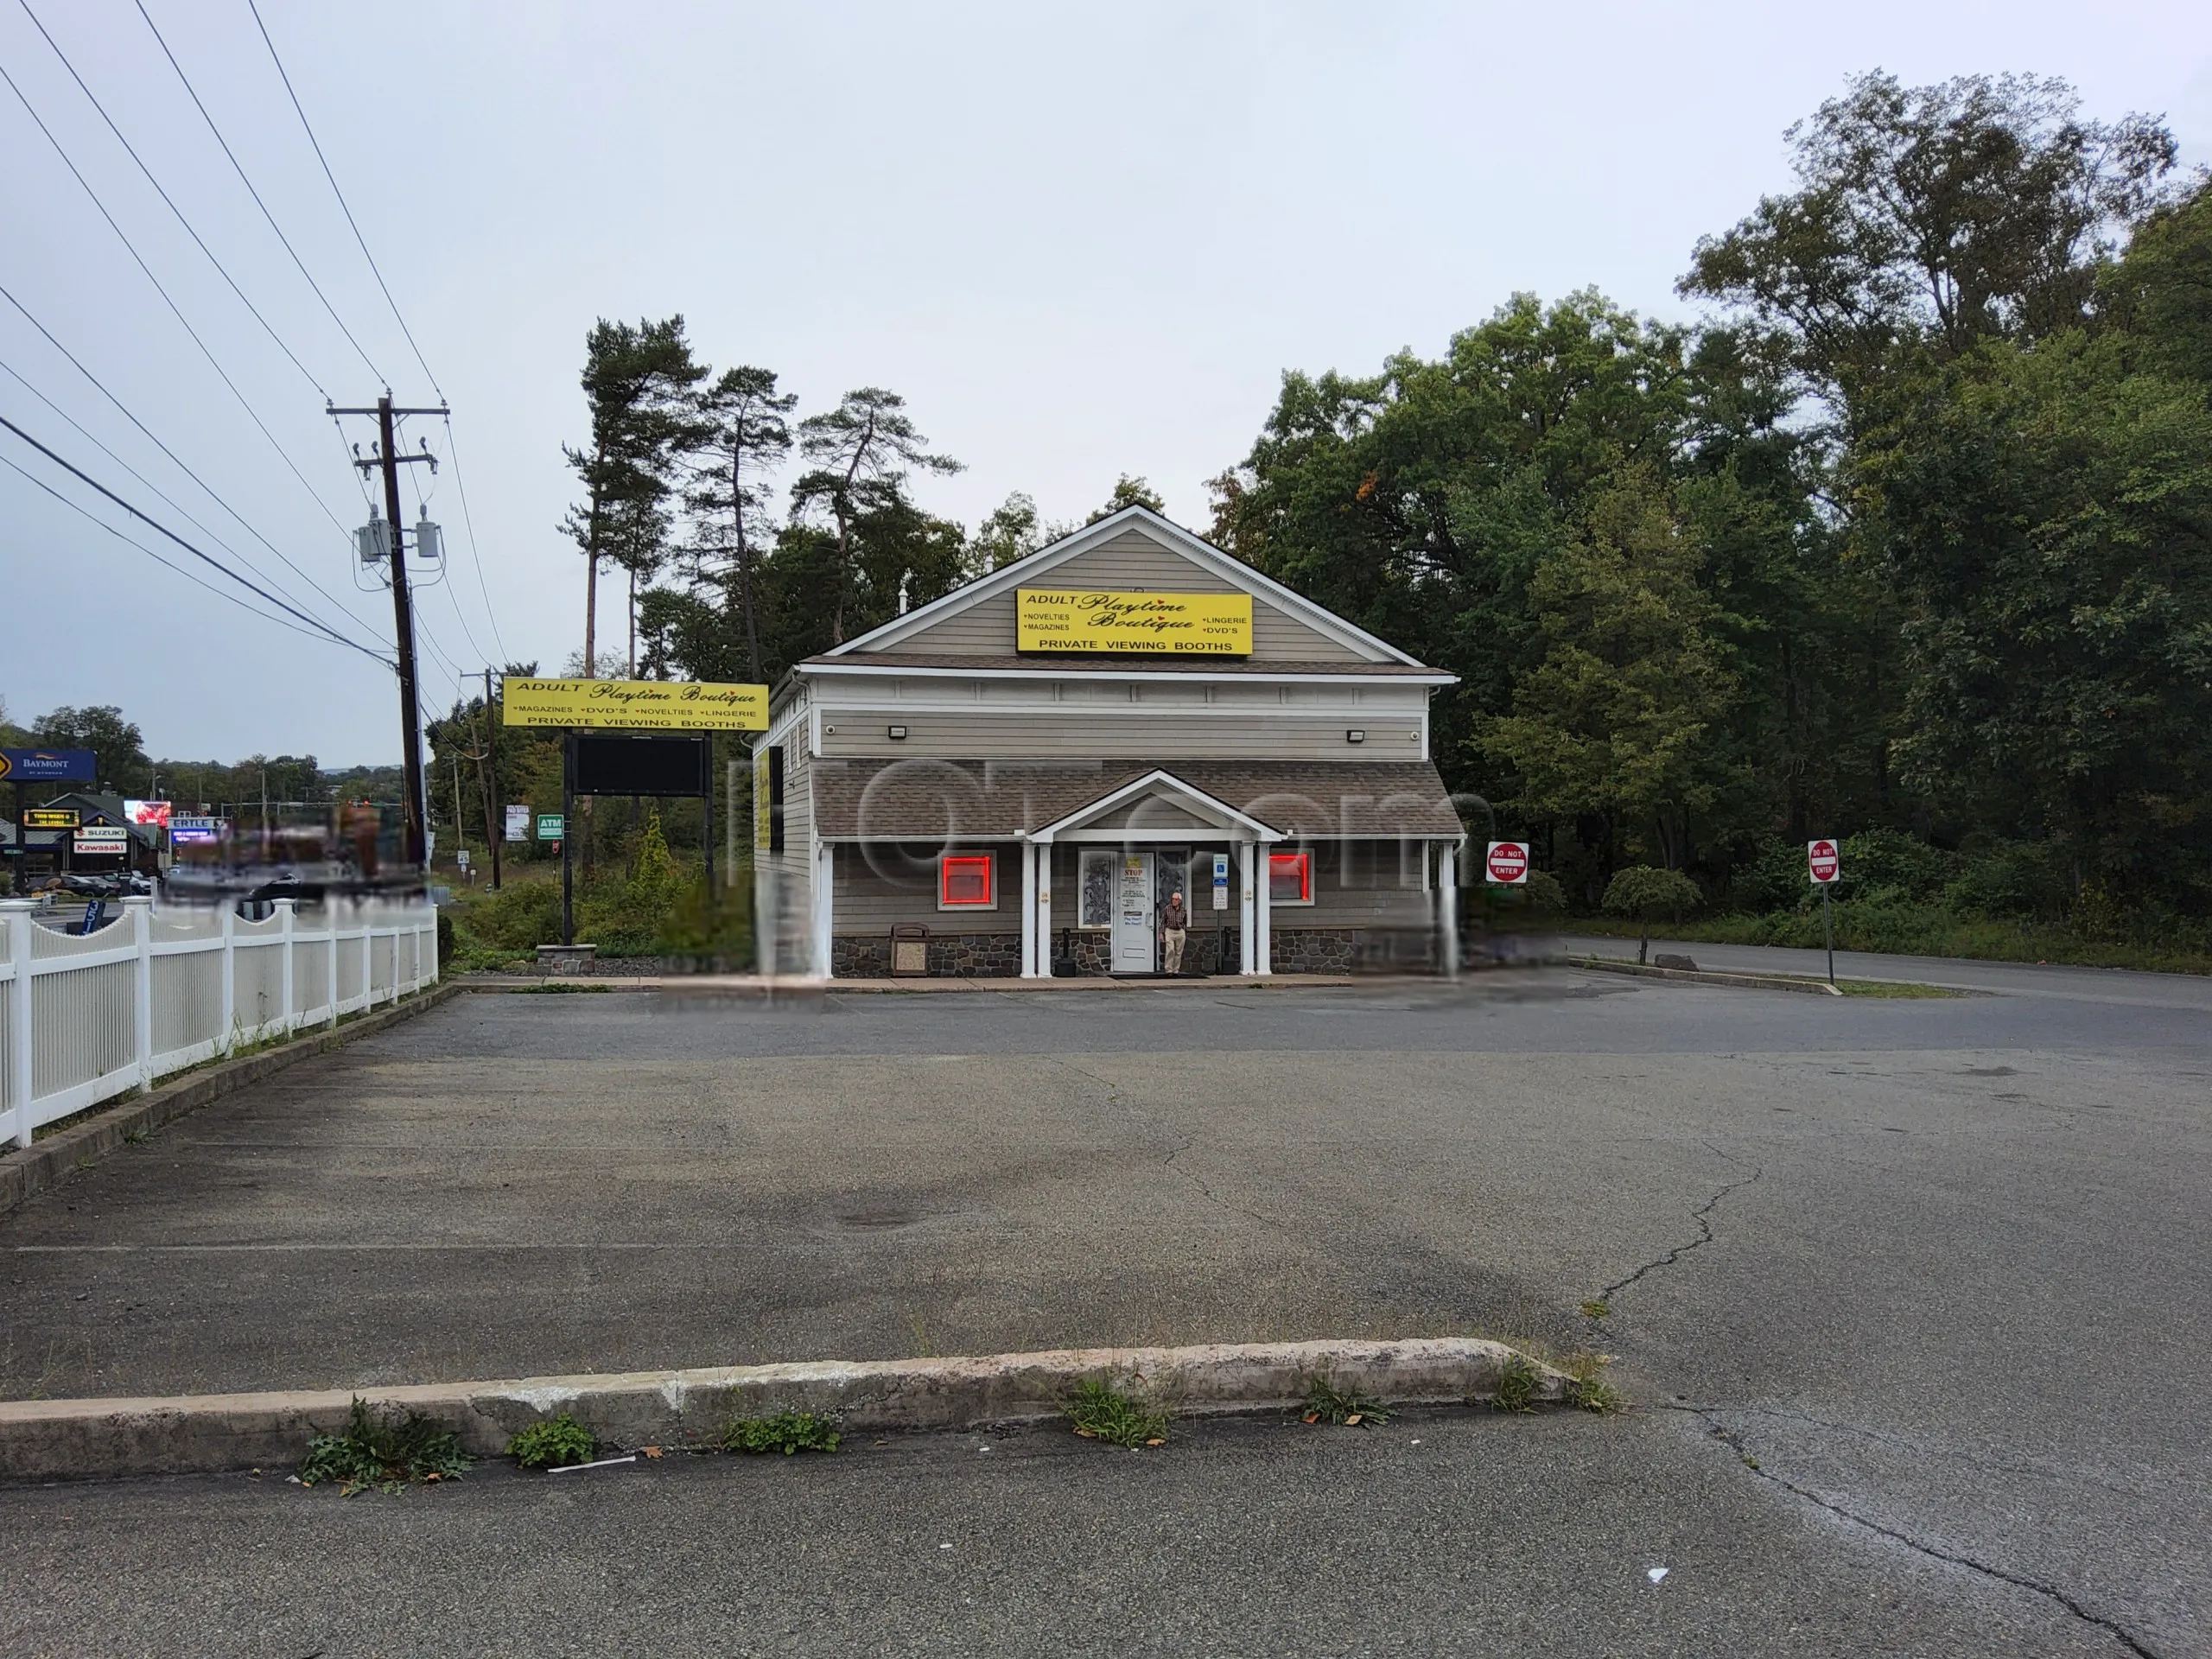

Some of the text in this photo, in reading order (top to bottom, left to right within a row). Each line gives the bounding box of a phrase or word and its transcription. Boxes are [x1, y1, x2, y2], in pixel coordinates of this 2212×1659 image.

[1026, 594, 1187, 616] ADULT Playtime
[1027, 613, 1071, 621] NOVELTIES
[1087, 611, 1195, 633] Boutique
[1027, 623, 1070, 632] MAGAZINES
[1039, 639, 1233, 651] PRIVATE VIEWING BOOTHS
[516, 683, 757, 707] ADULT Playtime Boutique
[518, 705, 573, 714] MAGAZINES
[705, 709, 757, 718] LINGERIE
[527, 716, 747, 728] PRIVATE VIEWING BOOTHS
[22, 759, 69, 768] BAYMONT
[173, 819, 208, 828] ERTLE
[540, 818, 562, 828] ATM
[1822, 848, 1833, 856] NOT
[1815, 866, 1832, 874] ENTER
